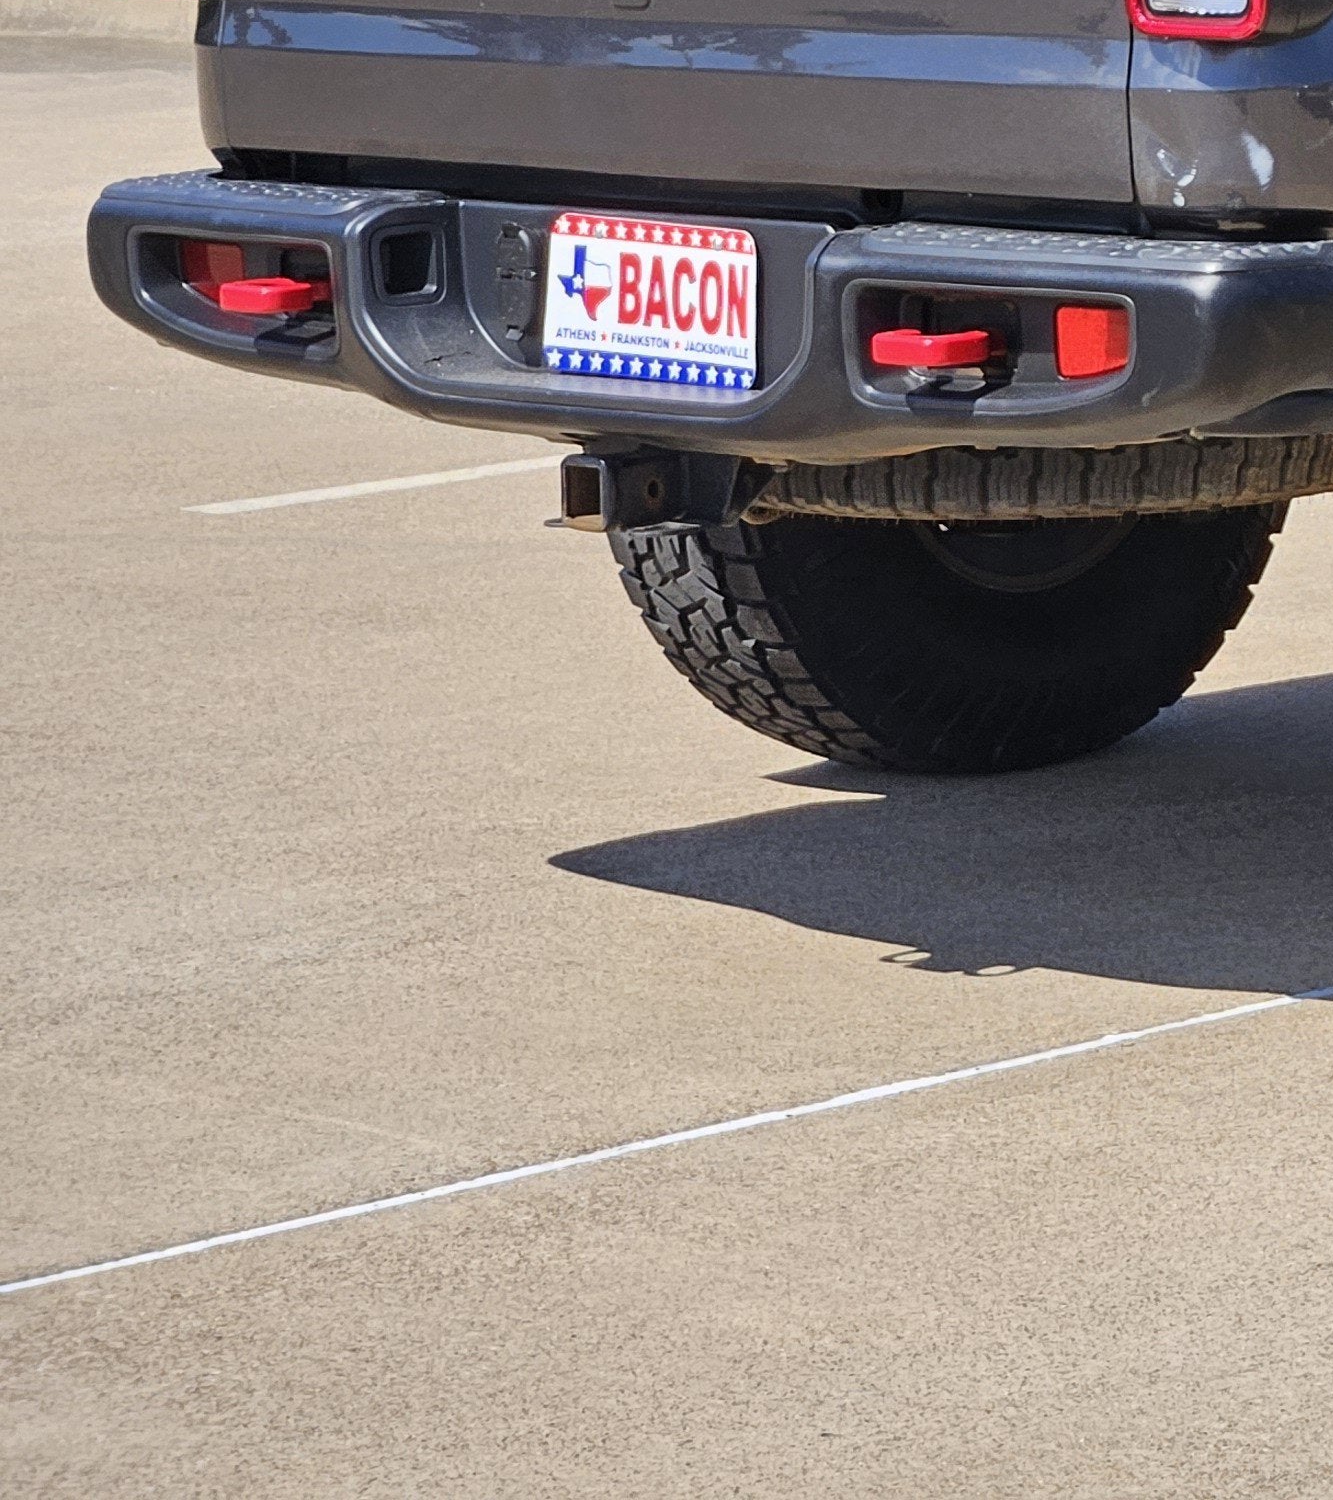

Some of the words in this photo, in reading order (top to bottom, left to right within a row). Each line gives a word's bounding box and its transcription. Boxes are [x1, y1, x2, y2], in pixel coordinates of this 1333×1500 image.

[617, 251, 749, 339] BACON
[555, 326, 597, 342] ATHENS
[610, 331, 670, 350] FRANKSTON
[683, 339, 749, 360] JACKSONVILLE
